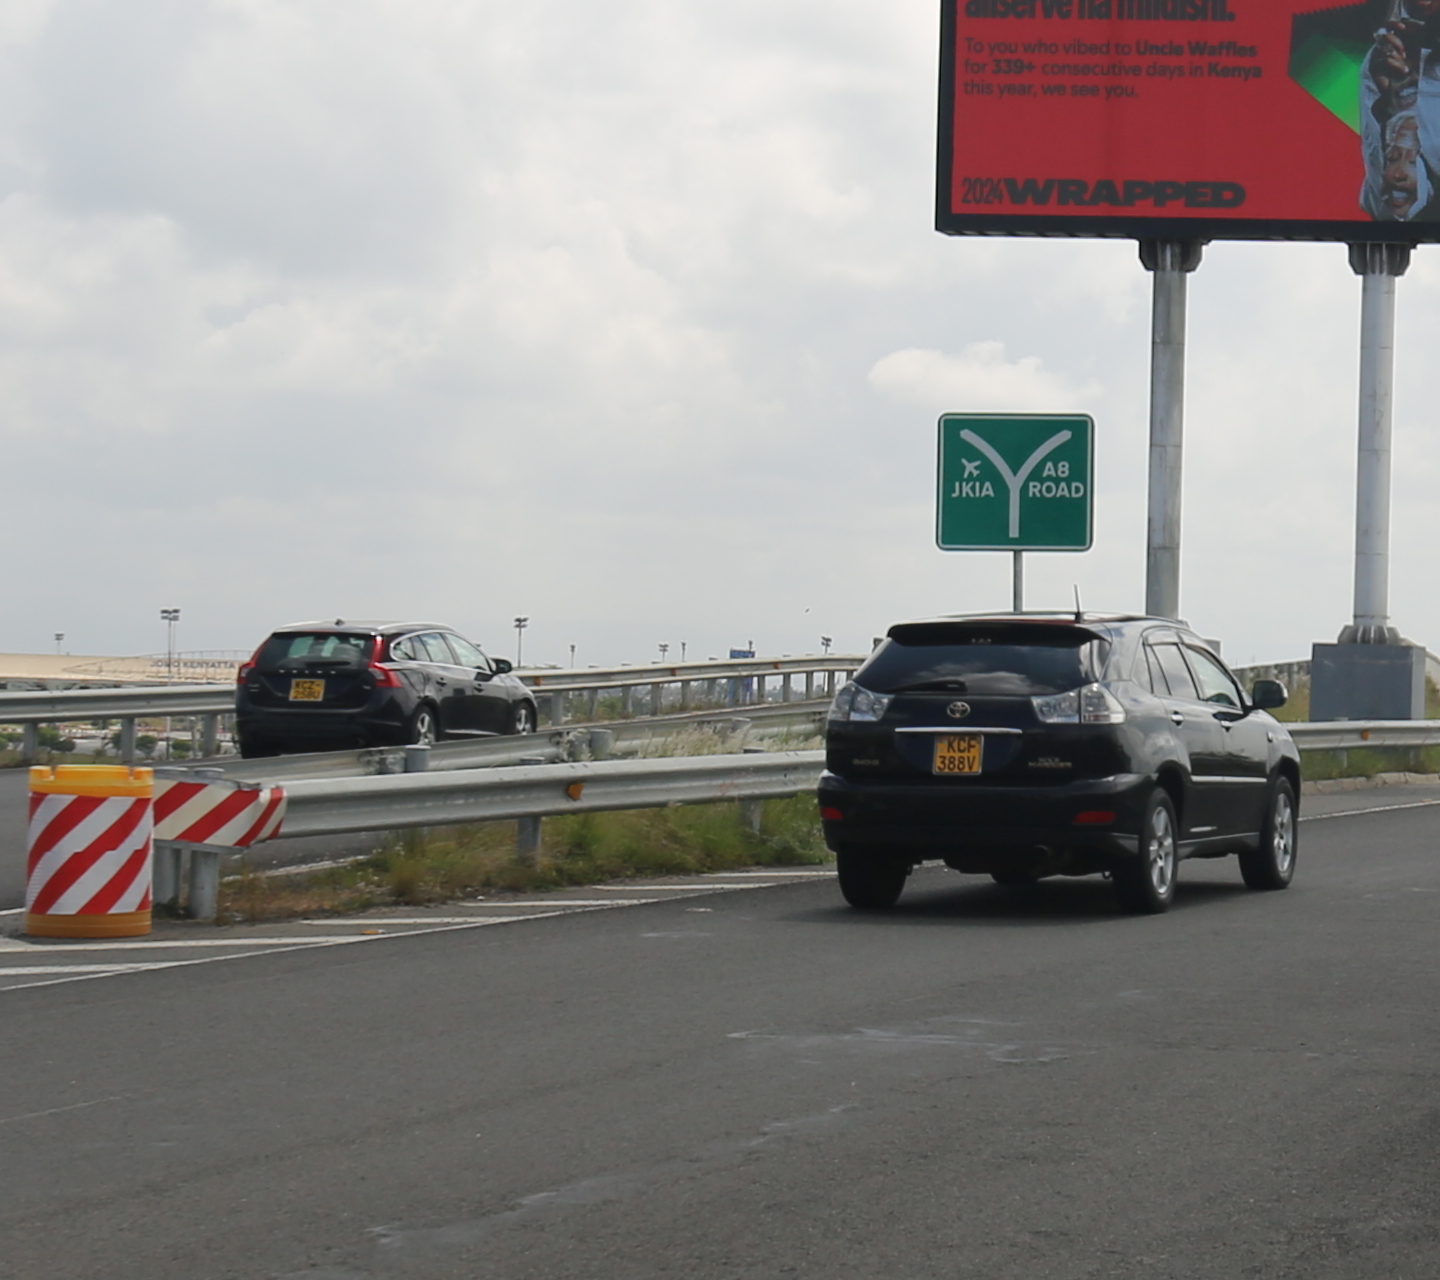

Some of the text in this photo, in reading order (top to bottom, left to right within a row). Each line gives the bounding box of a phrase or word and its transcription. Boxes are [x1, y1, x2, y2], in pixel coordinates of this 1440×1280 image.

[965, 37, 1257, 57] To you who vibed to Uncle Waffles
[964, 59, 1263, 81] for 339+ consecutive days in Kenya
[963, 79, 1138, 100] this year, we see you.
[961, 177, 1247, 209] 2024 WRAPPED
[1042, 461, 1070, 478] A8
[951, 481, 995, 498] JKIA
[1028, 482, 1085, 498] ROAD
[947, 736, 979, 754] KCF
[937, 755, 976, 772] 388V
